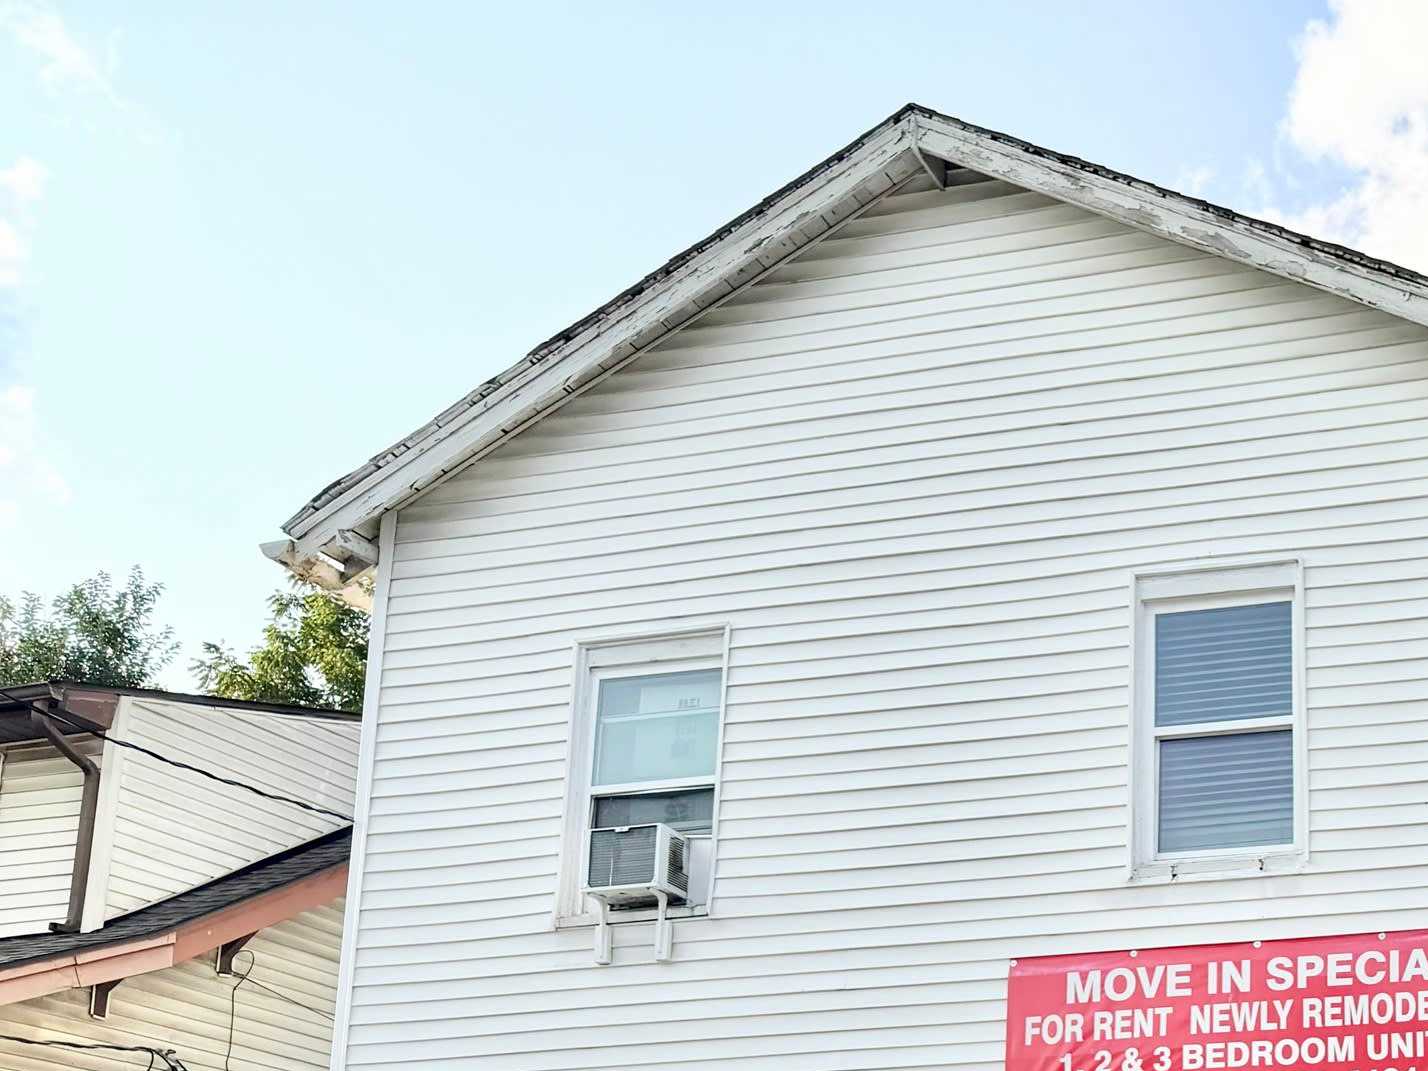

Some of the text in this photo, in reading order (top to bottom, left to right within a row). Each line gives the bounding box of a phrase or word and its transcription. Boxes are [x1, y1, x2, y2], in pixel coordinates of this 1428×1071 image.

[1066, 963, 1192, 1004] MOVE
[1207, 959, 1250, 995] IN
[1024, 1012, 1084, 1046] FOR
[1093, 1006, 1173, 1041] RENT
[1190, 999, 1294, 1035] NEWLY
[1153, 1046, 1172, 1071] 3
[1182, 1035, 1355, 1070] BEDROOM
